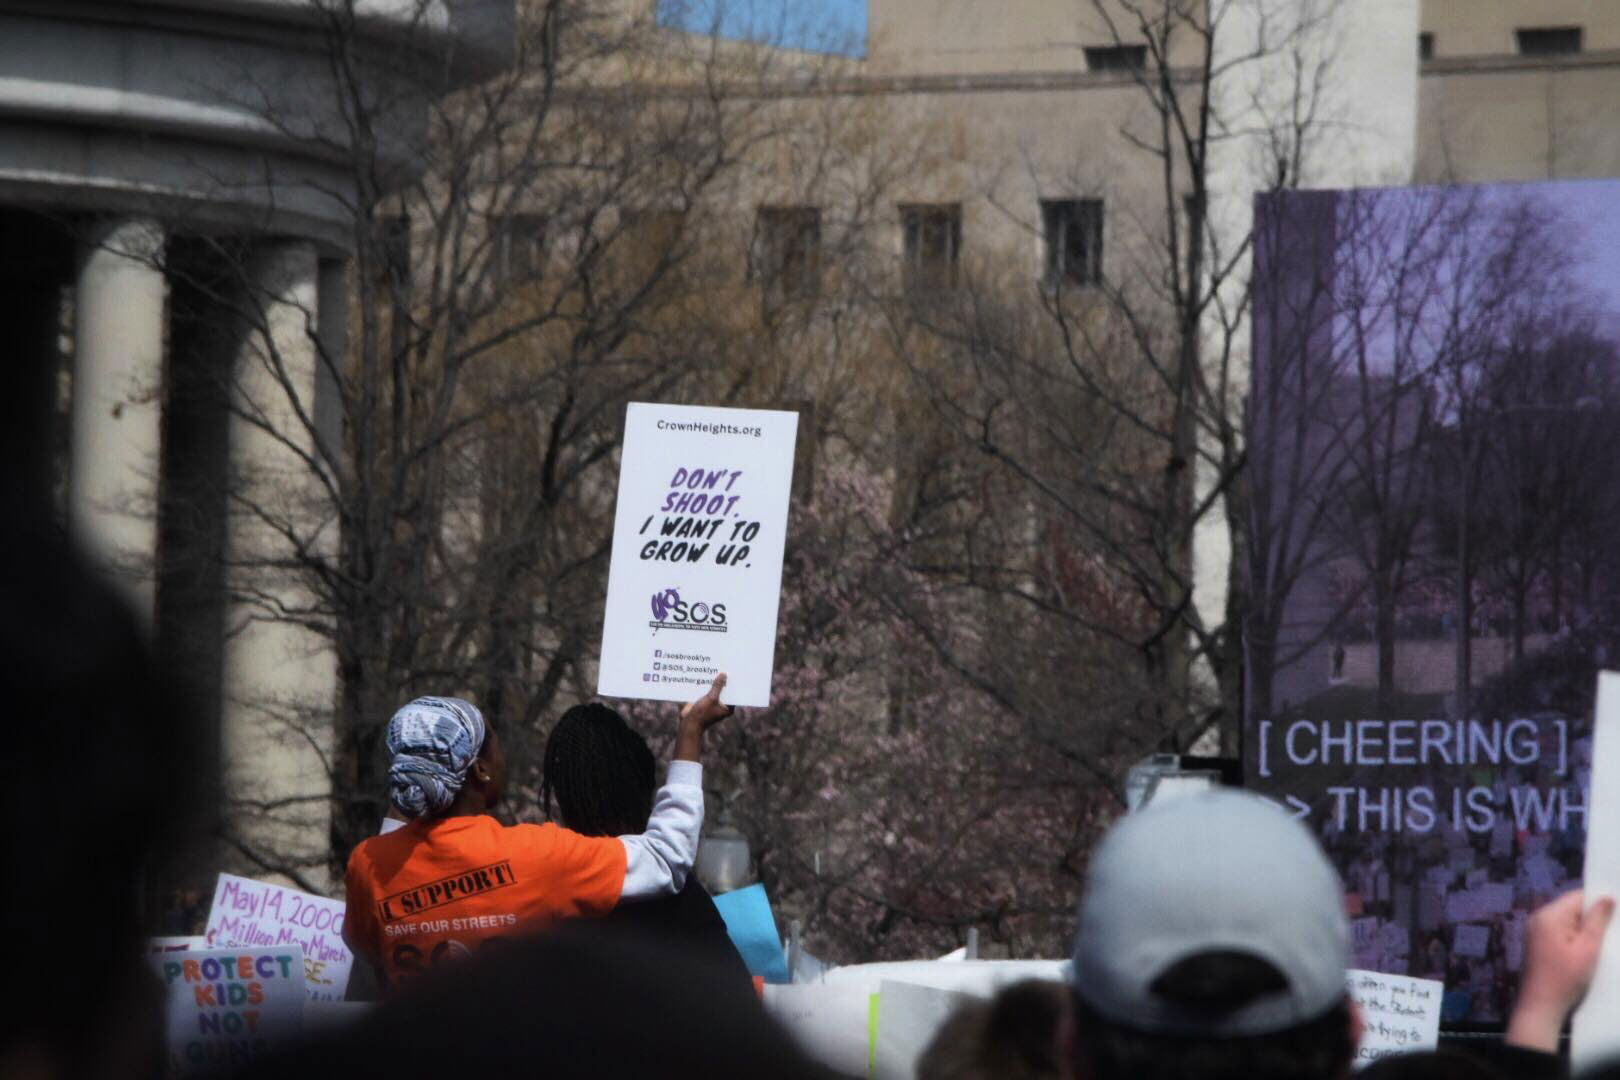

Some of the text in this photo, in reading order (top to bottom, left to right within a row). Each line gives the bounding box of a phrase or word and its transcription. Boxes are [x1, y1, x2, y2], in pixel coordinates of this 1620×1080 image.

[657, 419, 762, 438] CrownHeights.org
[670, 467, 743, 492] DON'T
[661, 491, 741, 518] SHOOT.
[639, 515, 761, 543] I WANT TO
[640, 540, 753, 569] GROW UP.
[1284, 719, 1542, 766] CHEERING
[1326, 786, 1437, 832] THIS
[1453, 786, 1497, 832] IS
[1509, 786, 1590, 832] WH
[219, 881, 260, 919] May
[400, 866, 509, 914] SUPPORT
[217, 915, 274, 947] Million
[307, 934, 348, 964] March
[384, 913, 517, 938] SAVE OUR STREETS
[164, 954, 293, 984] PROTECT
[194, 981, 265, 1007] KIDS
[197, 1009, 262, 1035] NOT
